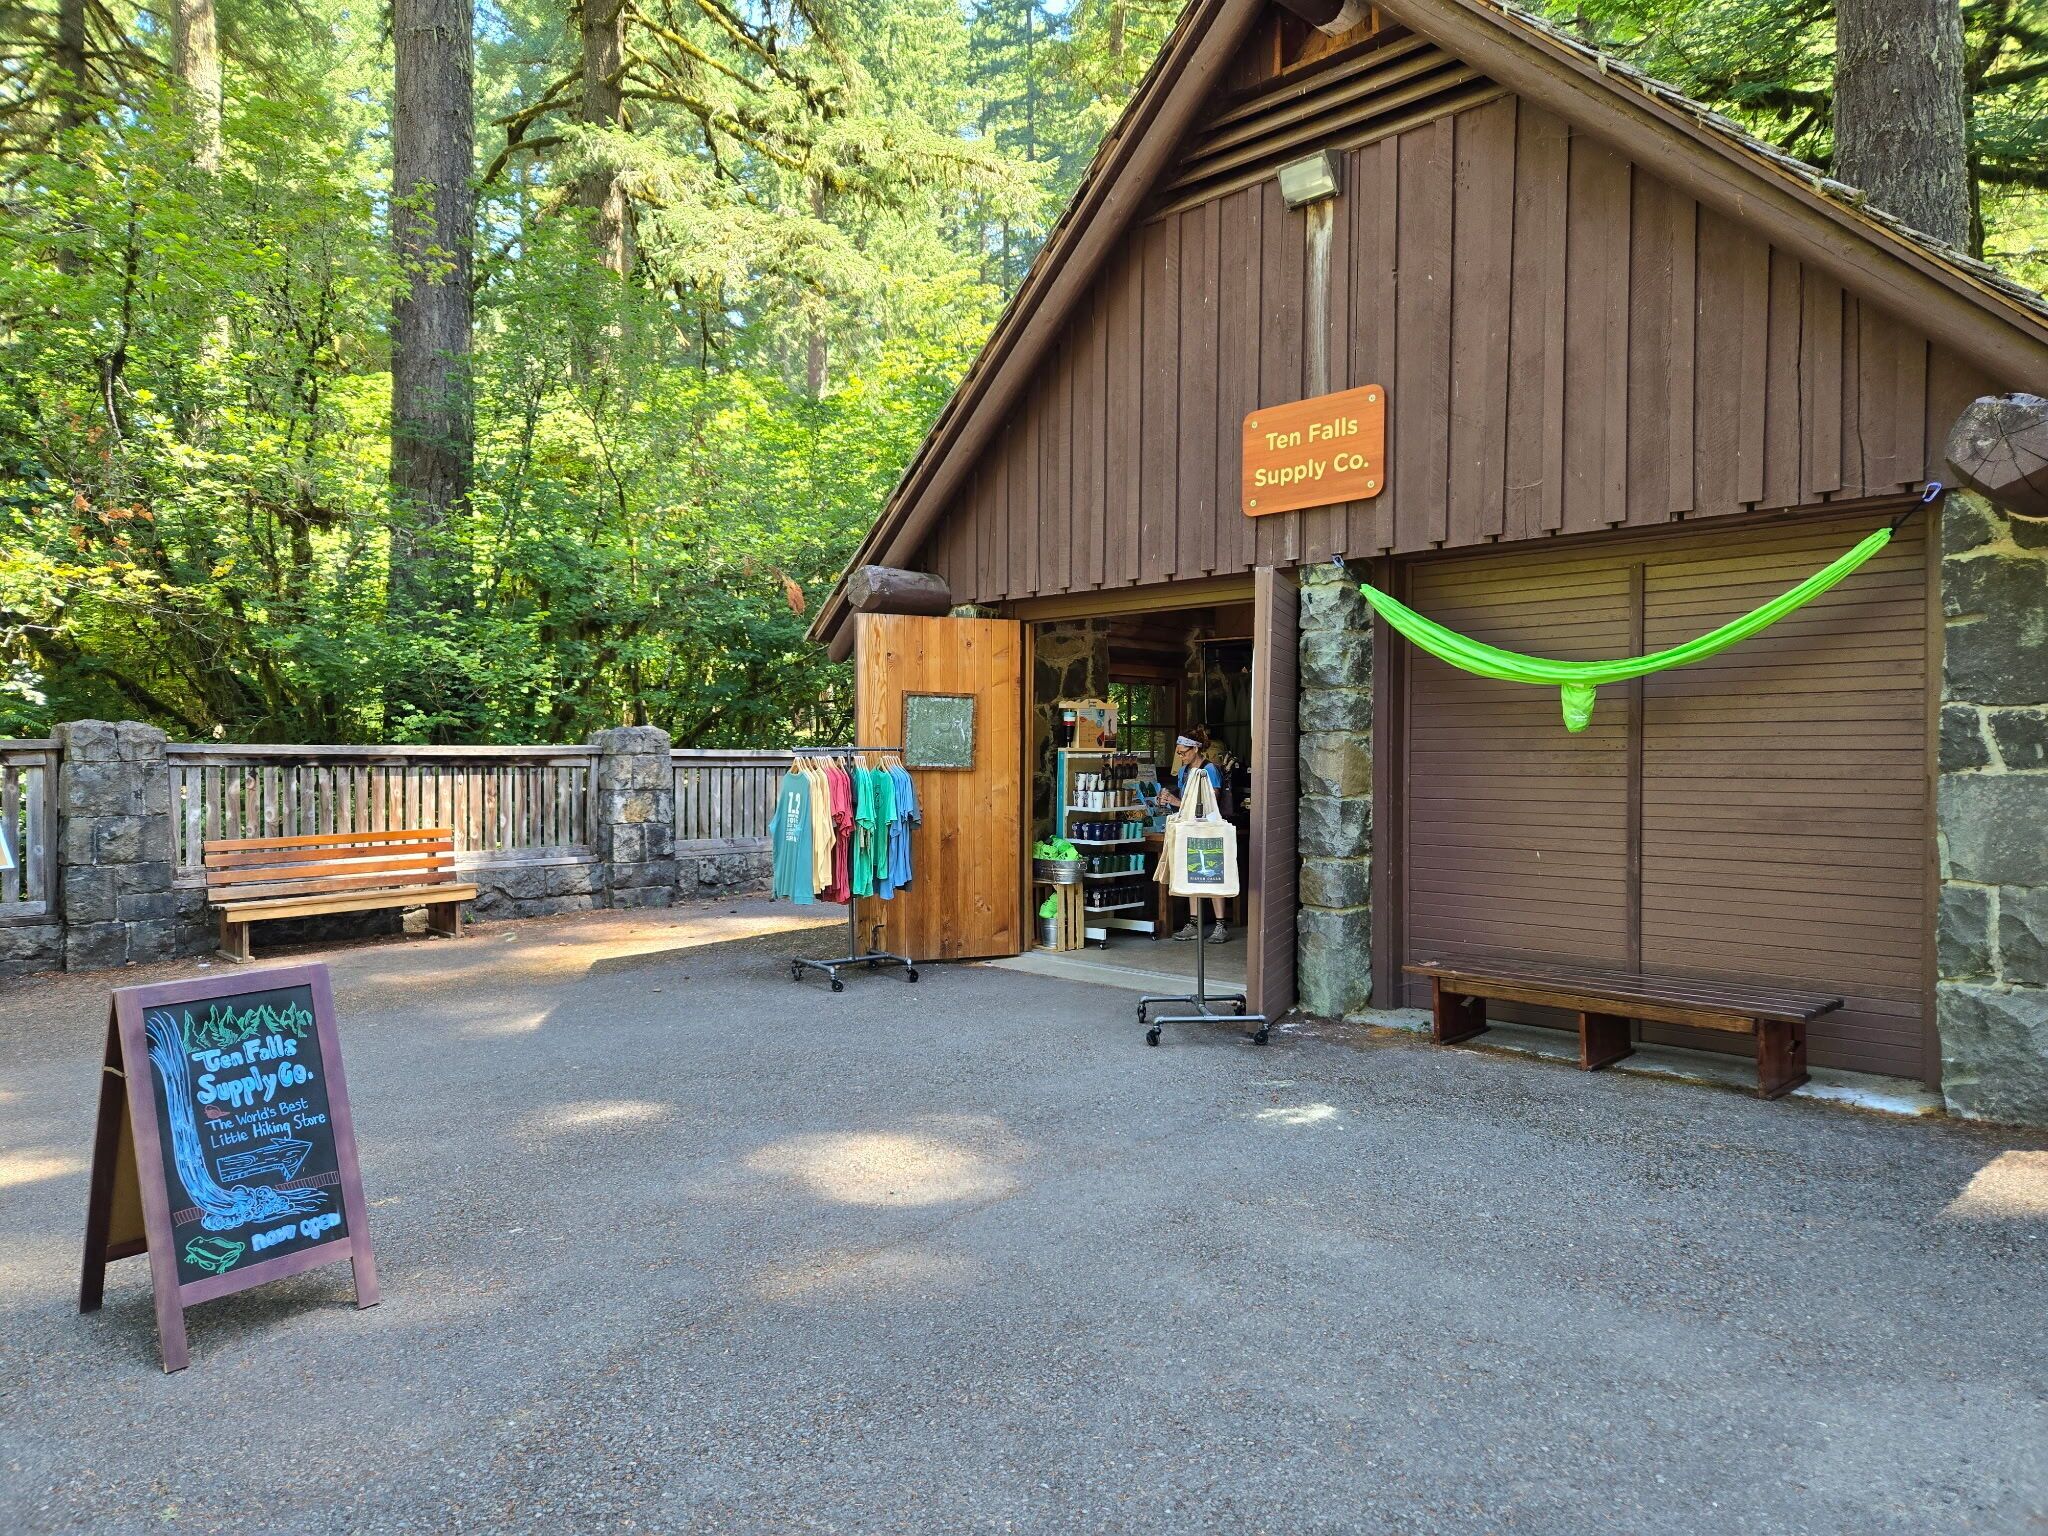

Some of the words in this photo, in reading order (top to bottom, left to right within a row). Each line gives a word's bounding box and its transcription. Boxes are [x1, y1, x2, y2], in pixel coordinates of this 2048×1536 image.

[1265, 431, 1301, 451] Ten
[1308, 417, 1358, 443] Falls
[1254, 459, 1327, 487] Supply
[1333, 453, 1369, 473] Co.
[191, 1049, 244, 1072] Ten
[242, 1034, 297, 1063] Falls
[196, 1066, 277, 1107] Supply
[204, 1119, 235, 1131] The
[235, 1107, 277, 1126] World's
[278, 1098, 308, 1116] Best
[210, 1130, 249, 1149] Little
[252, 1121, 291, 1141] Hiking
[293, 1112, 326, 1130] Store
